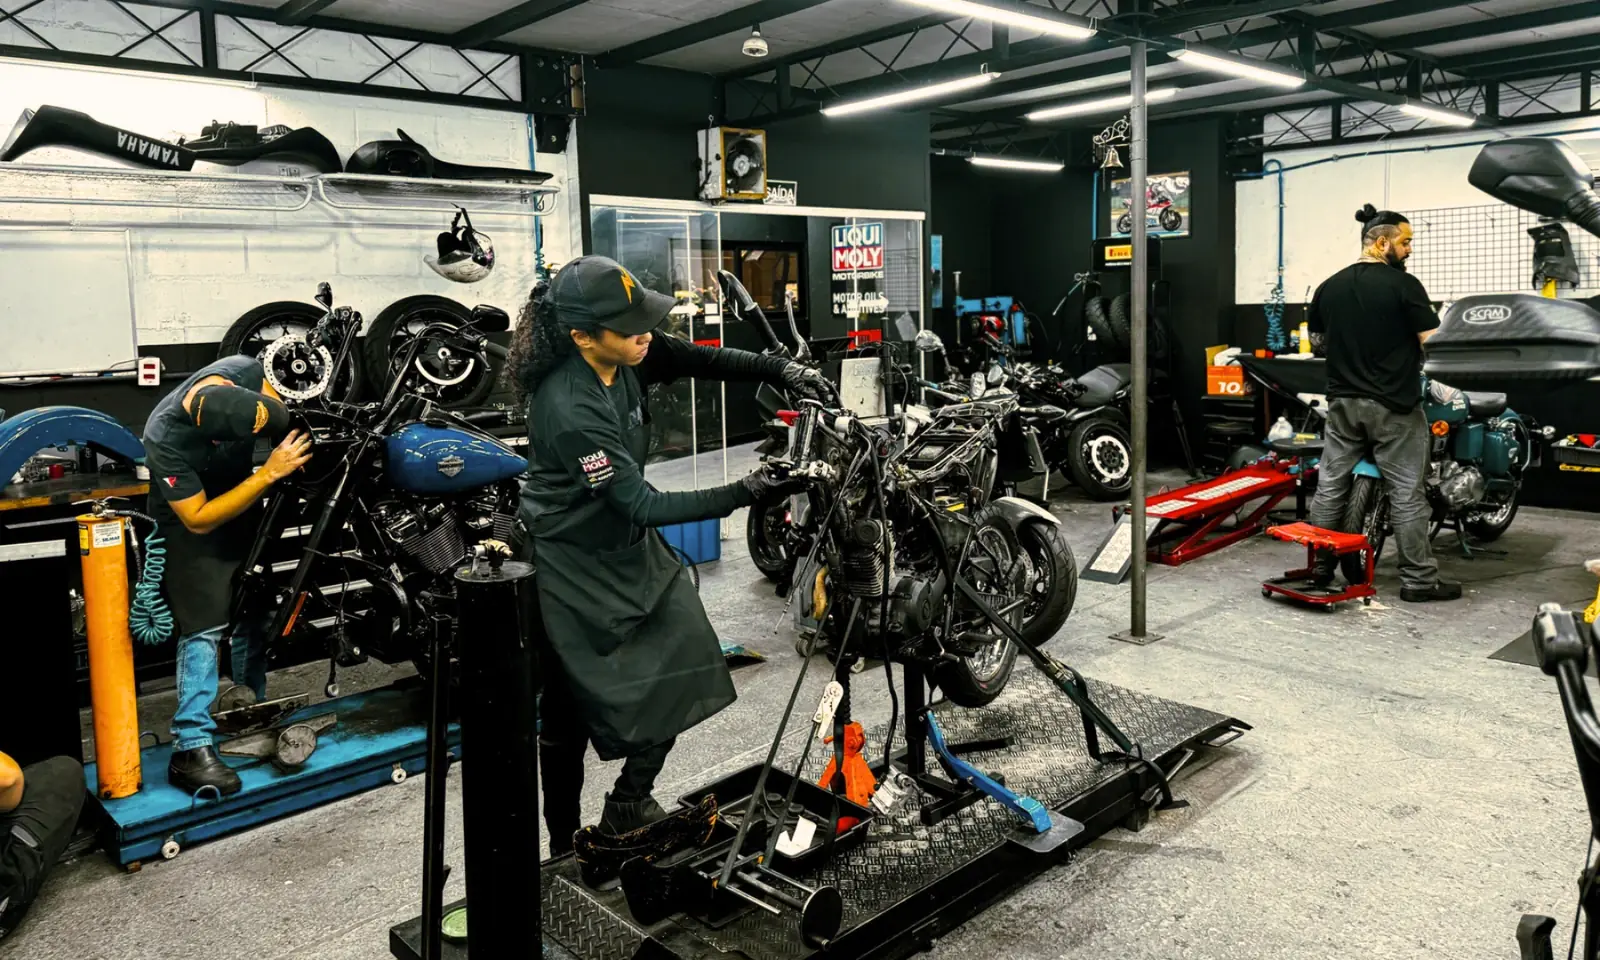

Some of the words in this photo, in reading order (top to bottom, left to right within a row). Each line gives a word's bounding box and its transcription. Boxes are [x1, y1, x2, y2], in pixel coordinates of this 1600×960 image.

[117, 131, 180, 167] YAMAHA
[835, 225, 880, 247] LIQUI
[835, 247, 881, 268] MOLY
[832, 271, 884, 281] MOTORBIKE
[833, 304, 840, 314] &
[578, 450, 605, 464] LIQUI
[582, 457, 608, 472] MOLY
